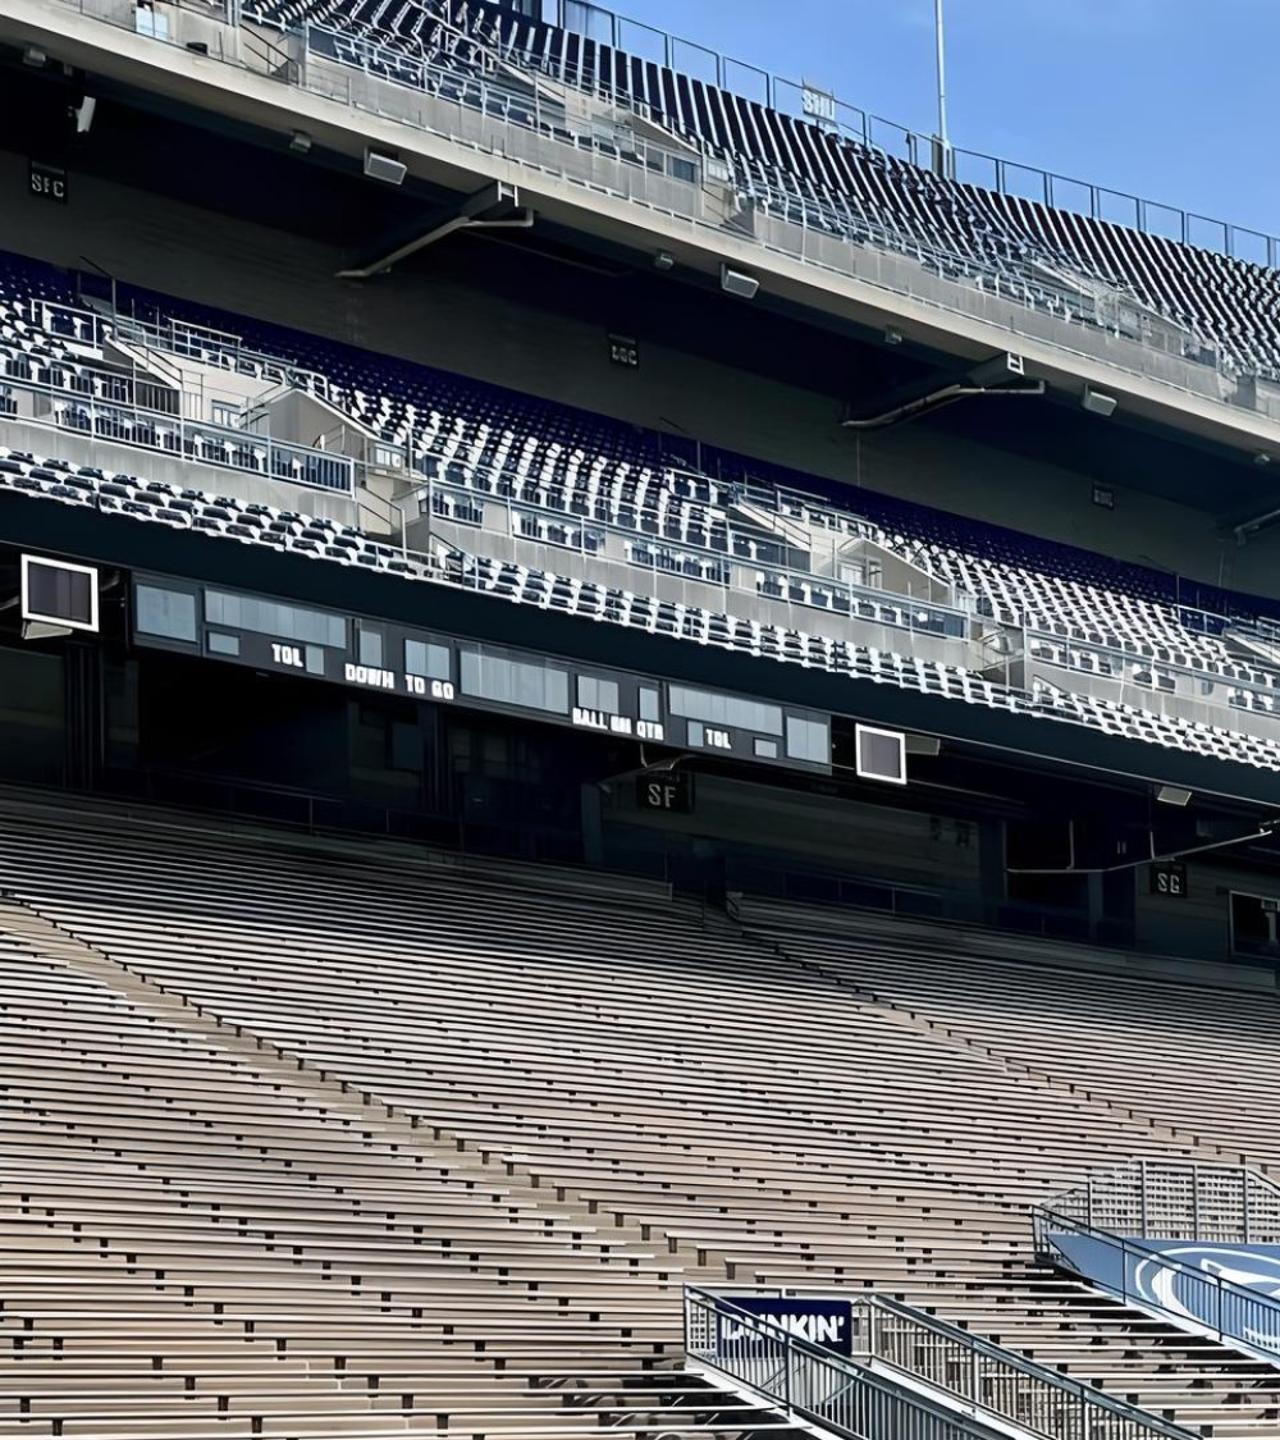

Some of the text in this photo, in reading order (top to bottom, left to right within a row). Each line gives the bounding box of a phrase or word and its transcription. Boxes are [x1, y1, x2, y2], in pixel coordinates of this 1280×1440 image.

[271, 643, 304, 668] TOL
[344, 662, 395, 689] DOWN
[405, 674, 425, 695] TO
[648, 783, 676, 808] SF
